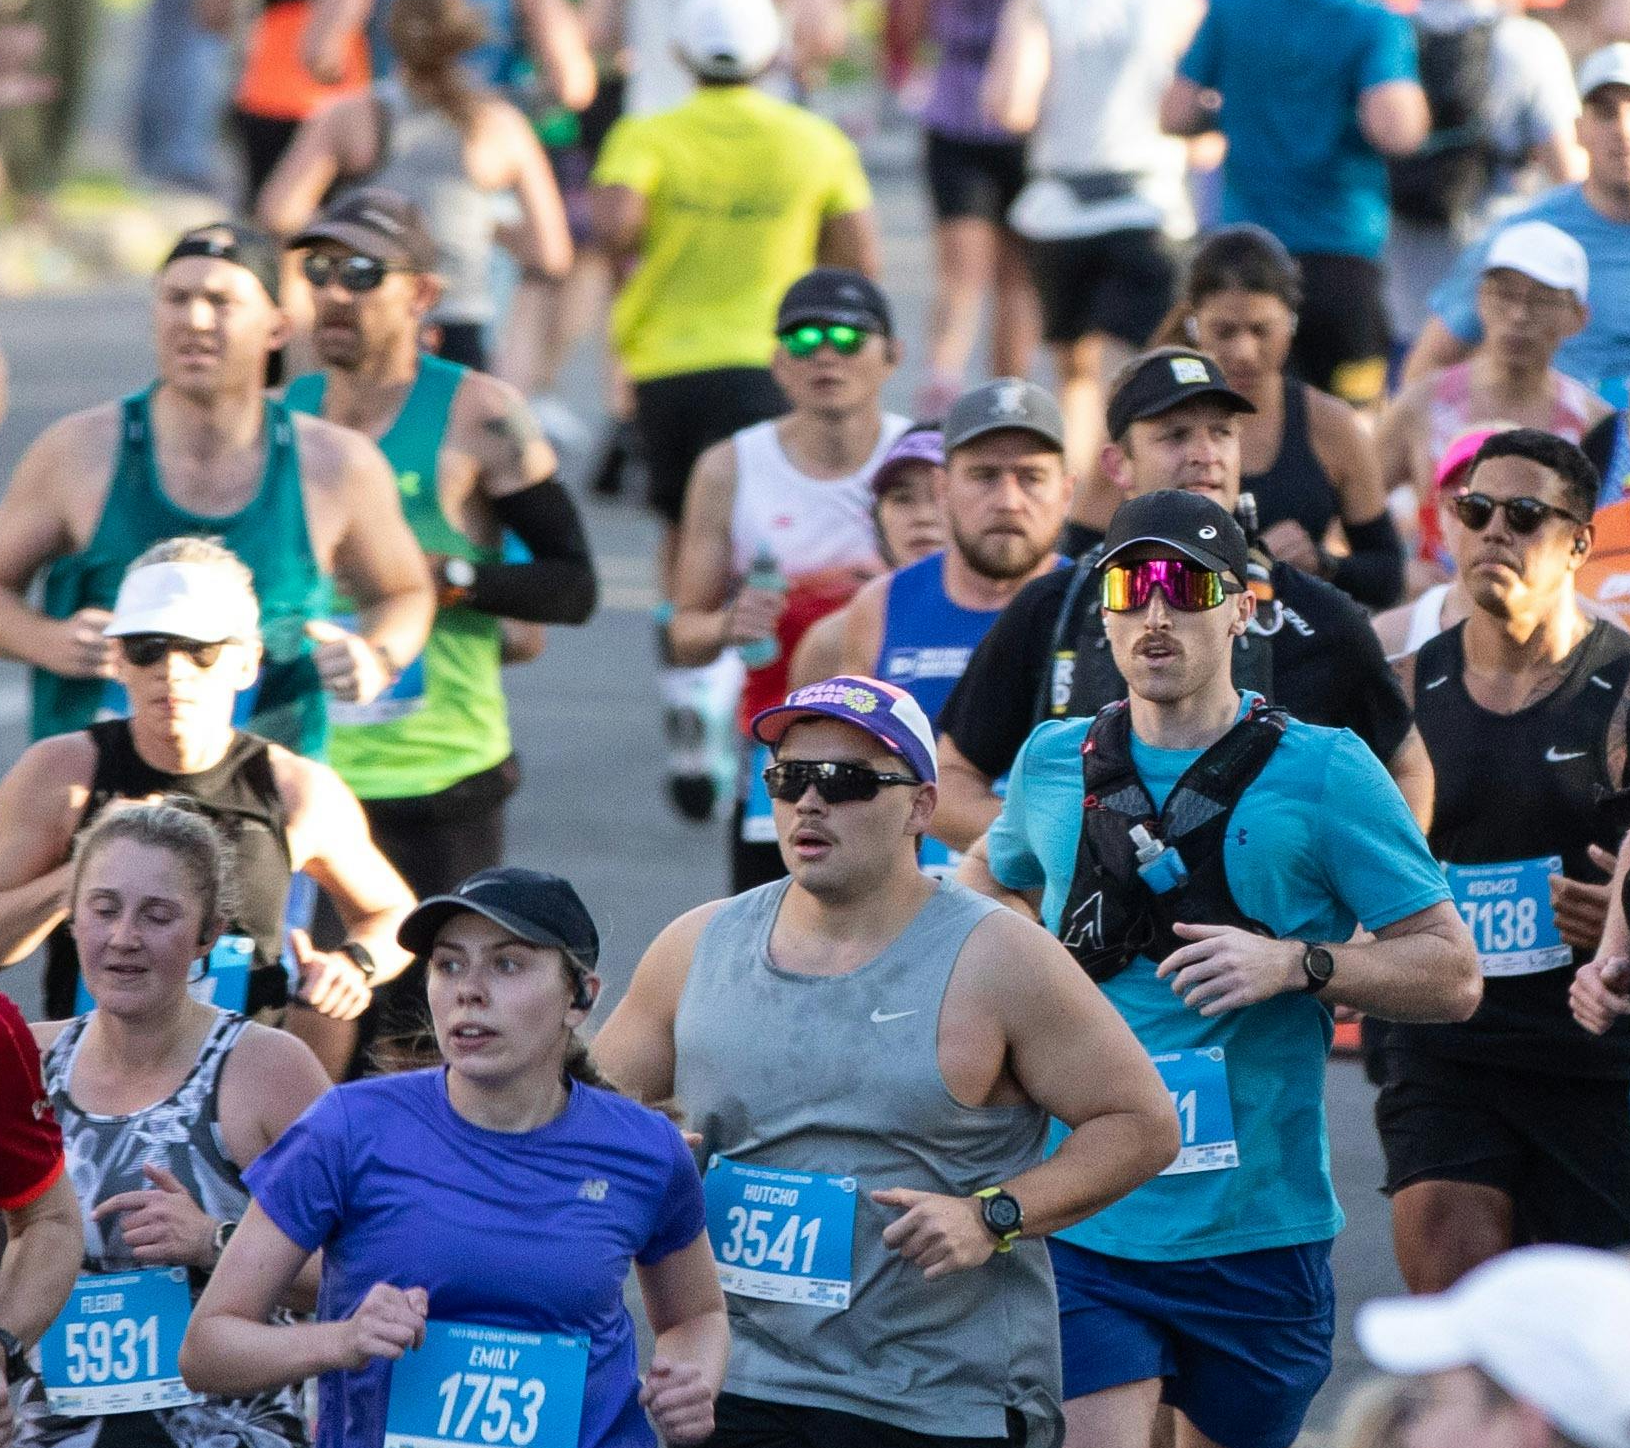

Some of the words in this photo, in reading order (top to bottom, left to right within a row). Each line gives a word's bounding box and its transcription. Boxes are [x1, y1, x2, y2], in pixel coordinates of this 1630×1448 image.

[1460, 897, 1538, 951] 7138
[743, 1183, 799, 1207] HUTCHO
[721, 1206, 822, 1274] 3541
[81, 1293, 125, 1314] FLEUR
[65, 1315, 159, 1384] 5931
[469, 1345, 520, 1370] EMILY
[437, 1371, 546, 1446] 1753
